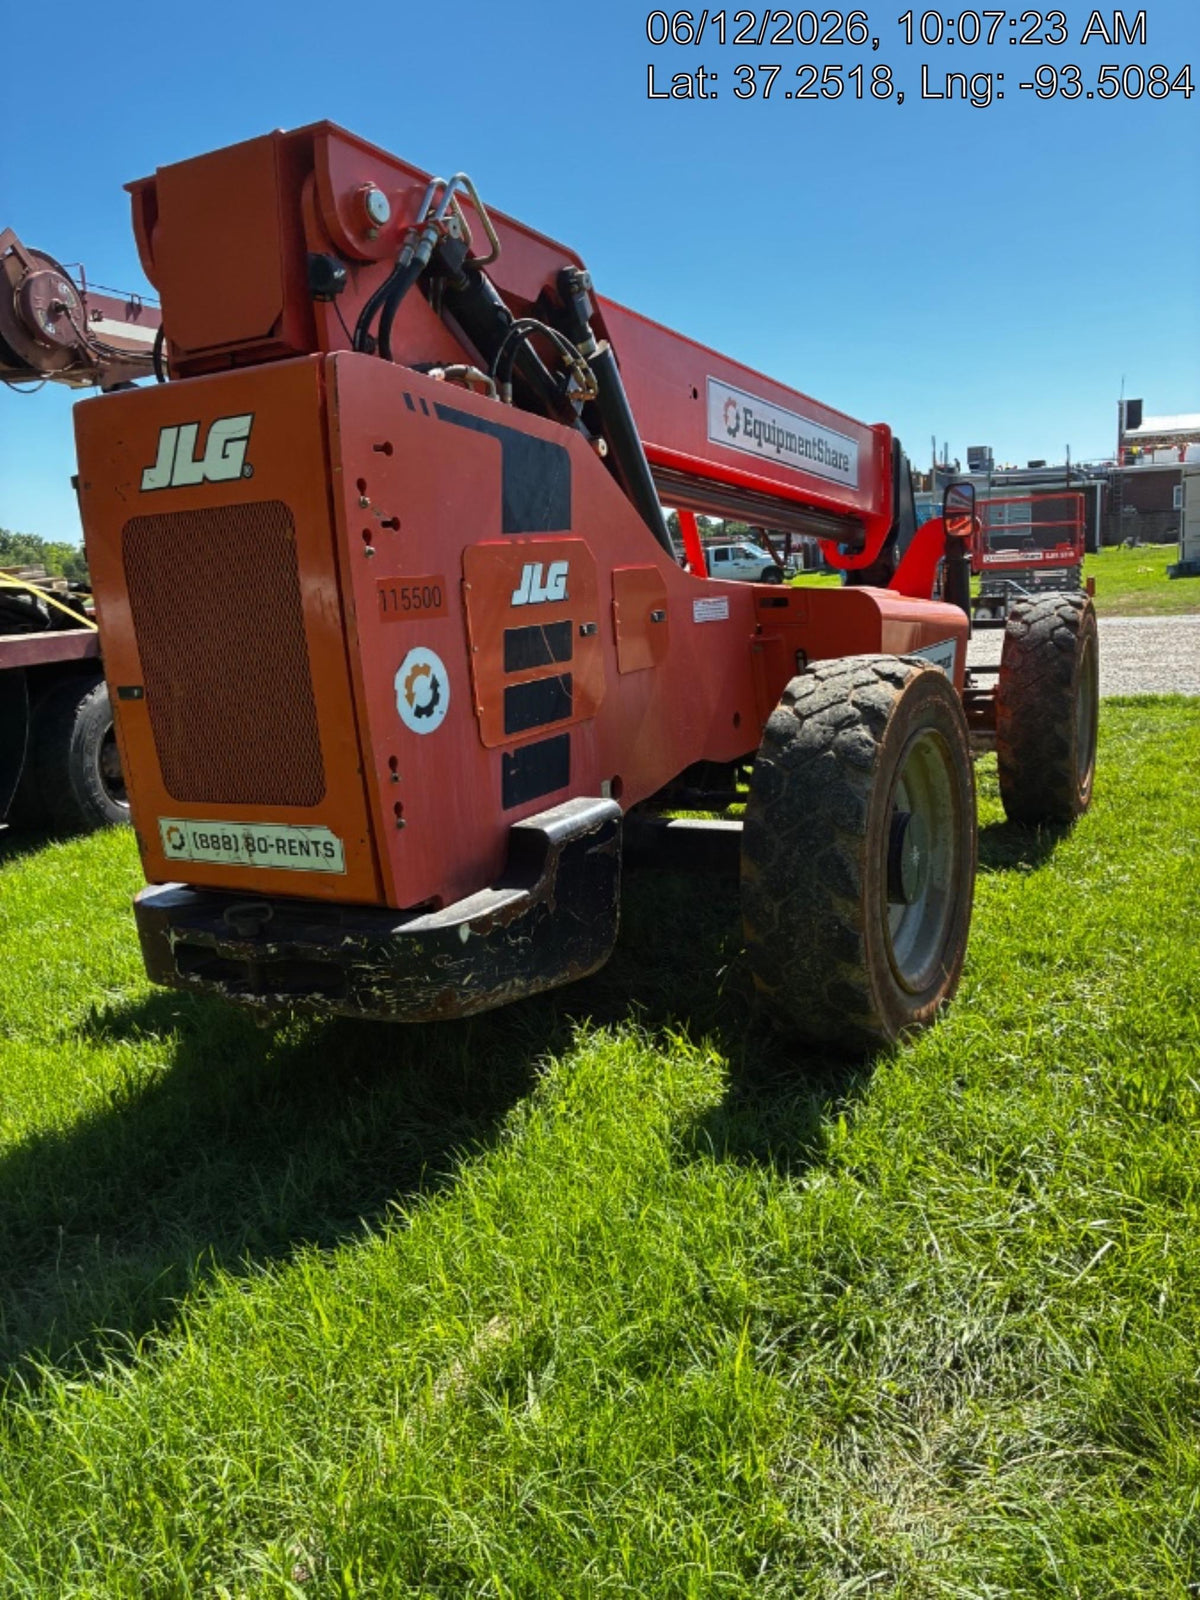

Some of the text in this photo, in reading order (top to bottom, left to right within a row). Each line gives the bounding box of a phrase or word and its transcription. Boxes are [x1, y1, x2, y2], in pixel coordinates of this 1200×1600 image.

[139, 412, 254, 492] JLG
[743, 407, 849, 472] EquipmentShare
[379, 586, 442, 612] 115500
[511, 561, 570, 607] JLG
